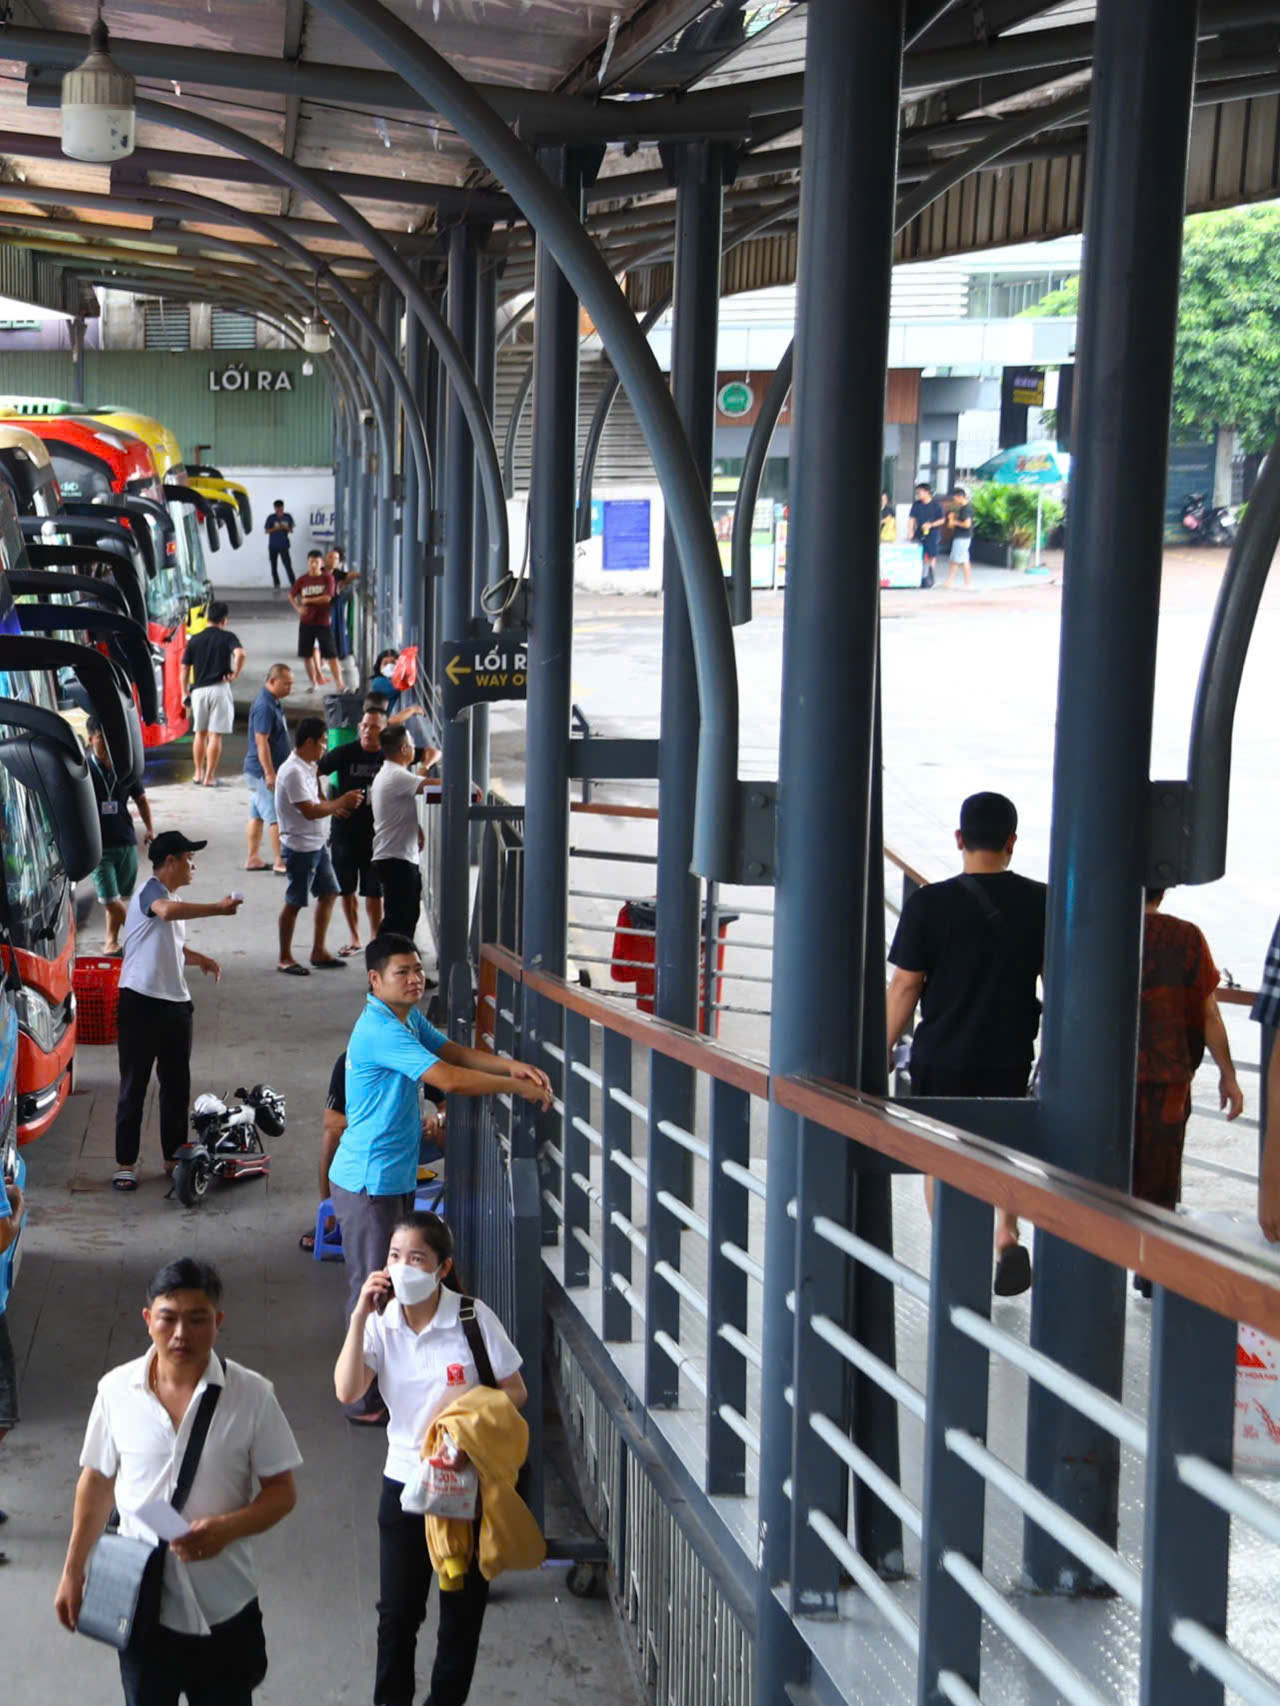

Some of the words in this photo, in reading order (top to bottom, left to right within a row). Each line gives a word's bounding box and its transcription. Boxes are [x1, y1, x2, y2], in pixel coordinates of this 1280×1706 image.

[209, 363, 249, 391] LỐI
[257, 371, 292, 391] RA
[475, 644, 506, 671] LỐI
[514, 653, 527, 670] R
[476, 674, 508, 687] WAY
[512, 673, 527, 686] O
